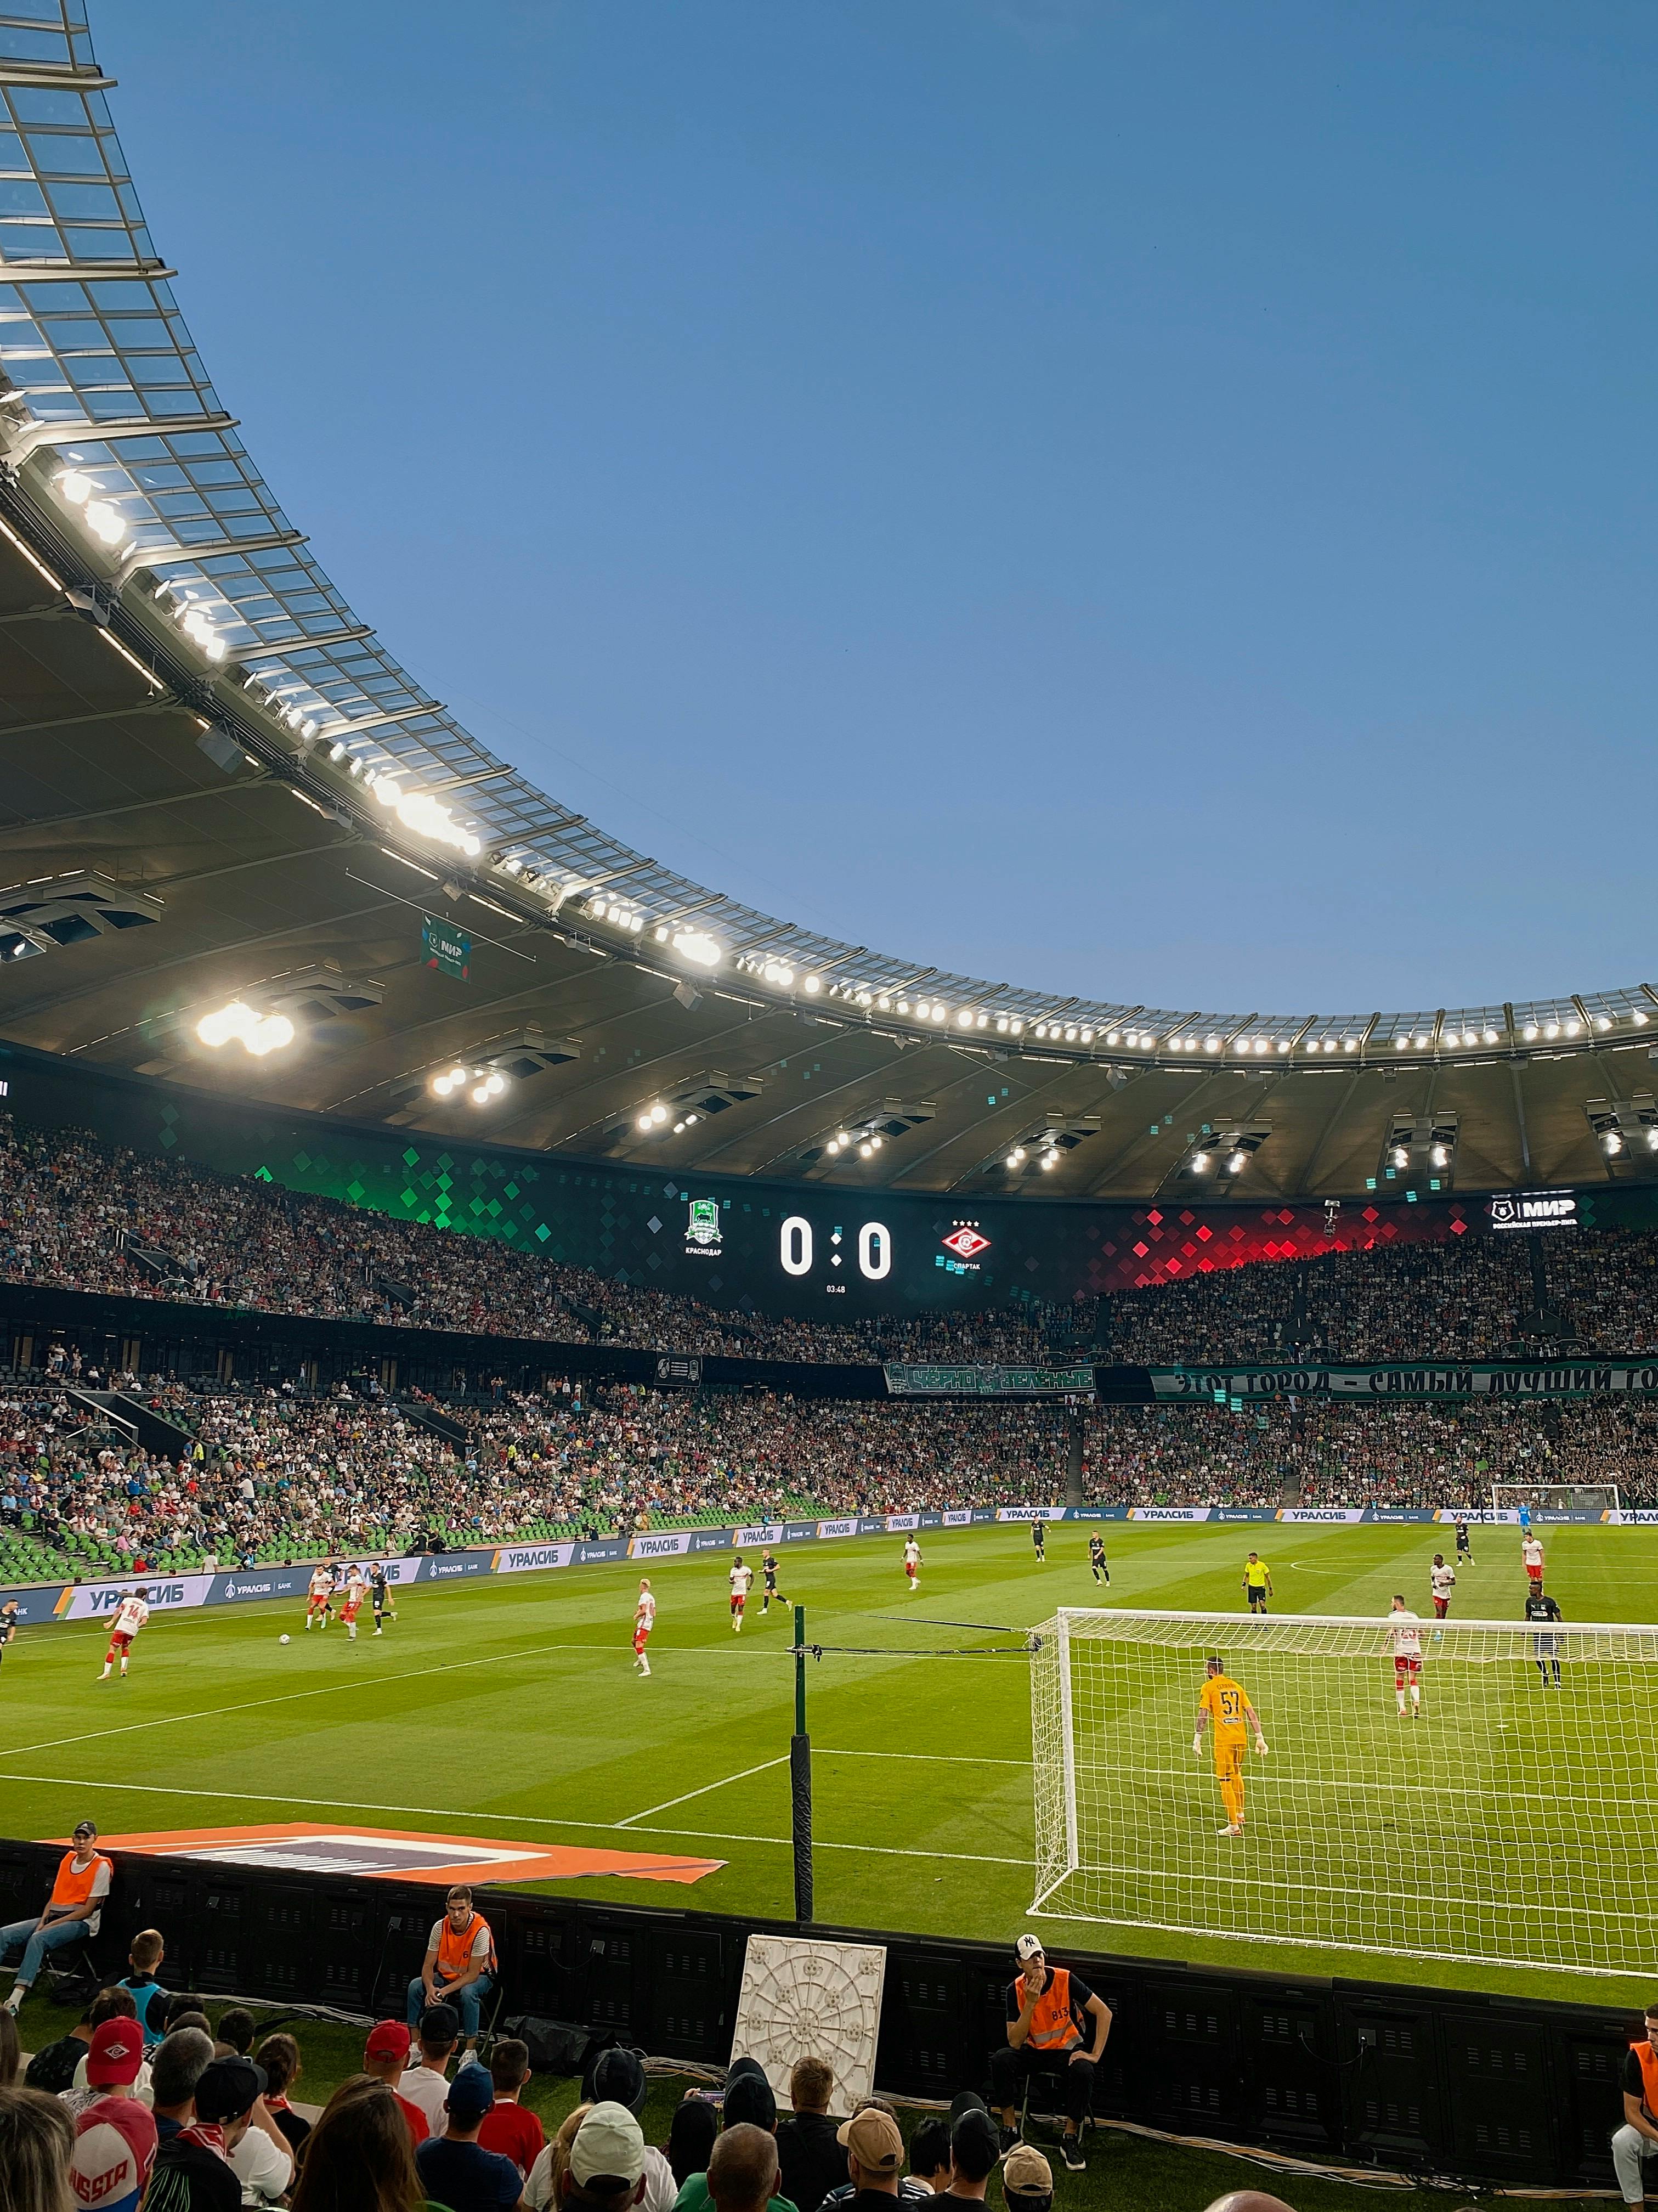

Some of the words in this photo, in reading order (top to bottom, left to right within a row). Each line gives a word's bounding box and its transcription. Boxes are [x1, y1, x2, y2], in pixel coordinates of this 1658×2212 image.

[1523, 1199, 1576, 1217] МИР
[685, 1247, 722, 1256] КРАСНОДАР
[780, 1216, 813, 1276] 0
[859, 1222, 891, 1280] 0
[827, 1285, 845, 1293] 03:48
[1175, 1373, 1234, 1394] ЭТОТ
[1246, 1370, 1333, 1396] ГОРОД
[1370, 1365, 1473, 1394] САМЫЙ
[1489, 1362, 1612, 1396] ЛУЧШИЙ
[948, 1513, 966, 1522] УРАЛСИБ
[1006, 1510, 1050, 1519] УРАЛСИБ
[1292, 1511, 1346, 1520] УРАЛСИБ
[892, 1517, 913, 1528] УРАЛСИБ
[825, 1523, 850, 1535] УРАЛСИБ
[743, 1530, 774, 1543] УРАЛСИБ
[641, 1539, 679, 1554] УРАЛСИБ
[509, 1550, 558, 1567] УРАЛСИБ
[438, 1565, 463, 1573] УРАЛСИБ
[237, 1583, 271, 1594] УРАЛСИБ
[127, 1604, 140, 1619] 14
[1220, 1691, 1239, 1715] 57
[463, 1950, 469, 1959] 6
[1051, 2006, 1070, 2021] 813
[69, 2159, 128, 2203] USSIA
